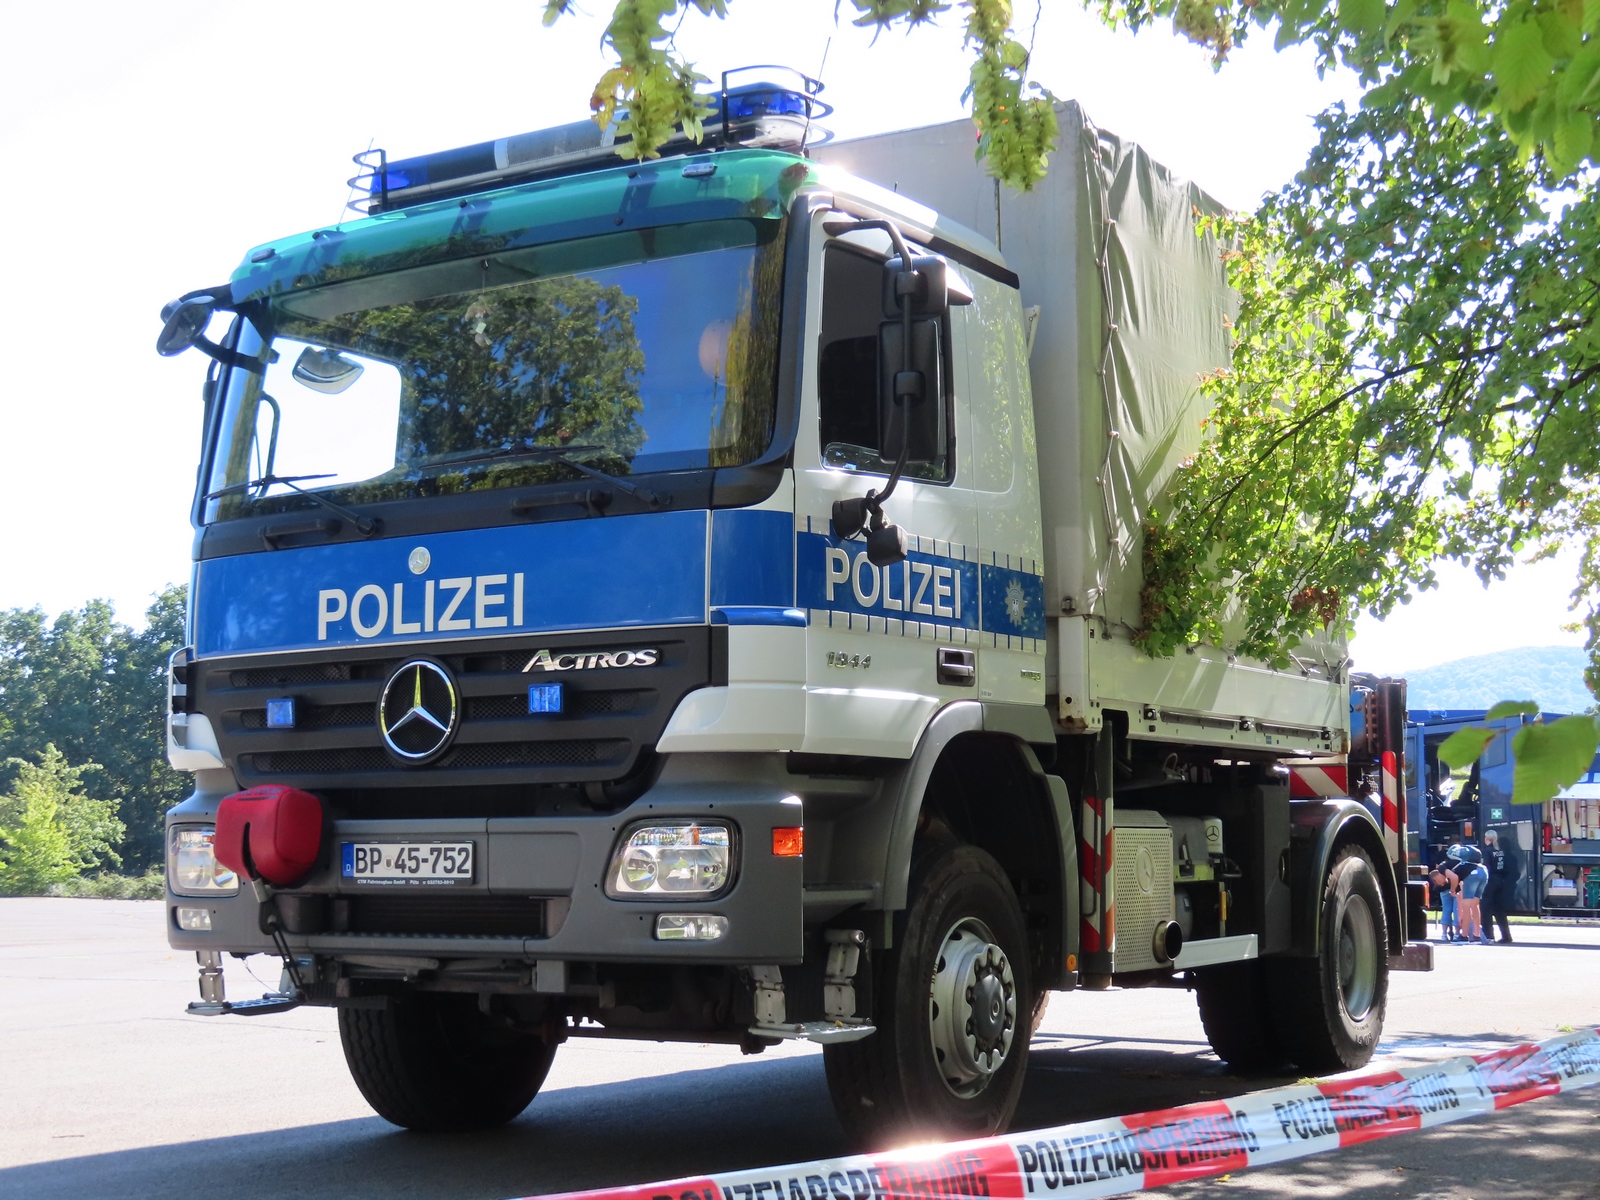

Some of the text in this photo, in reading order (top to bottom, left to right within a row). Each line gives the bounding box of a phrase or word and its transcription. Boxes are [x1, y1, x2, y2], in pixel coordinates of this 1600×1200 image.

[317, 572, 525, 641] POLIZEI
[825, 546, 962, 620] POLIZEI
[355, 847, 470, 874] BP 45-752
[652, 1153, 991, 1200] BSPERRUNG
[1015, 1109, 1261, 1193] POLIZEIABSPERRUNG
